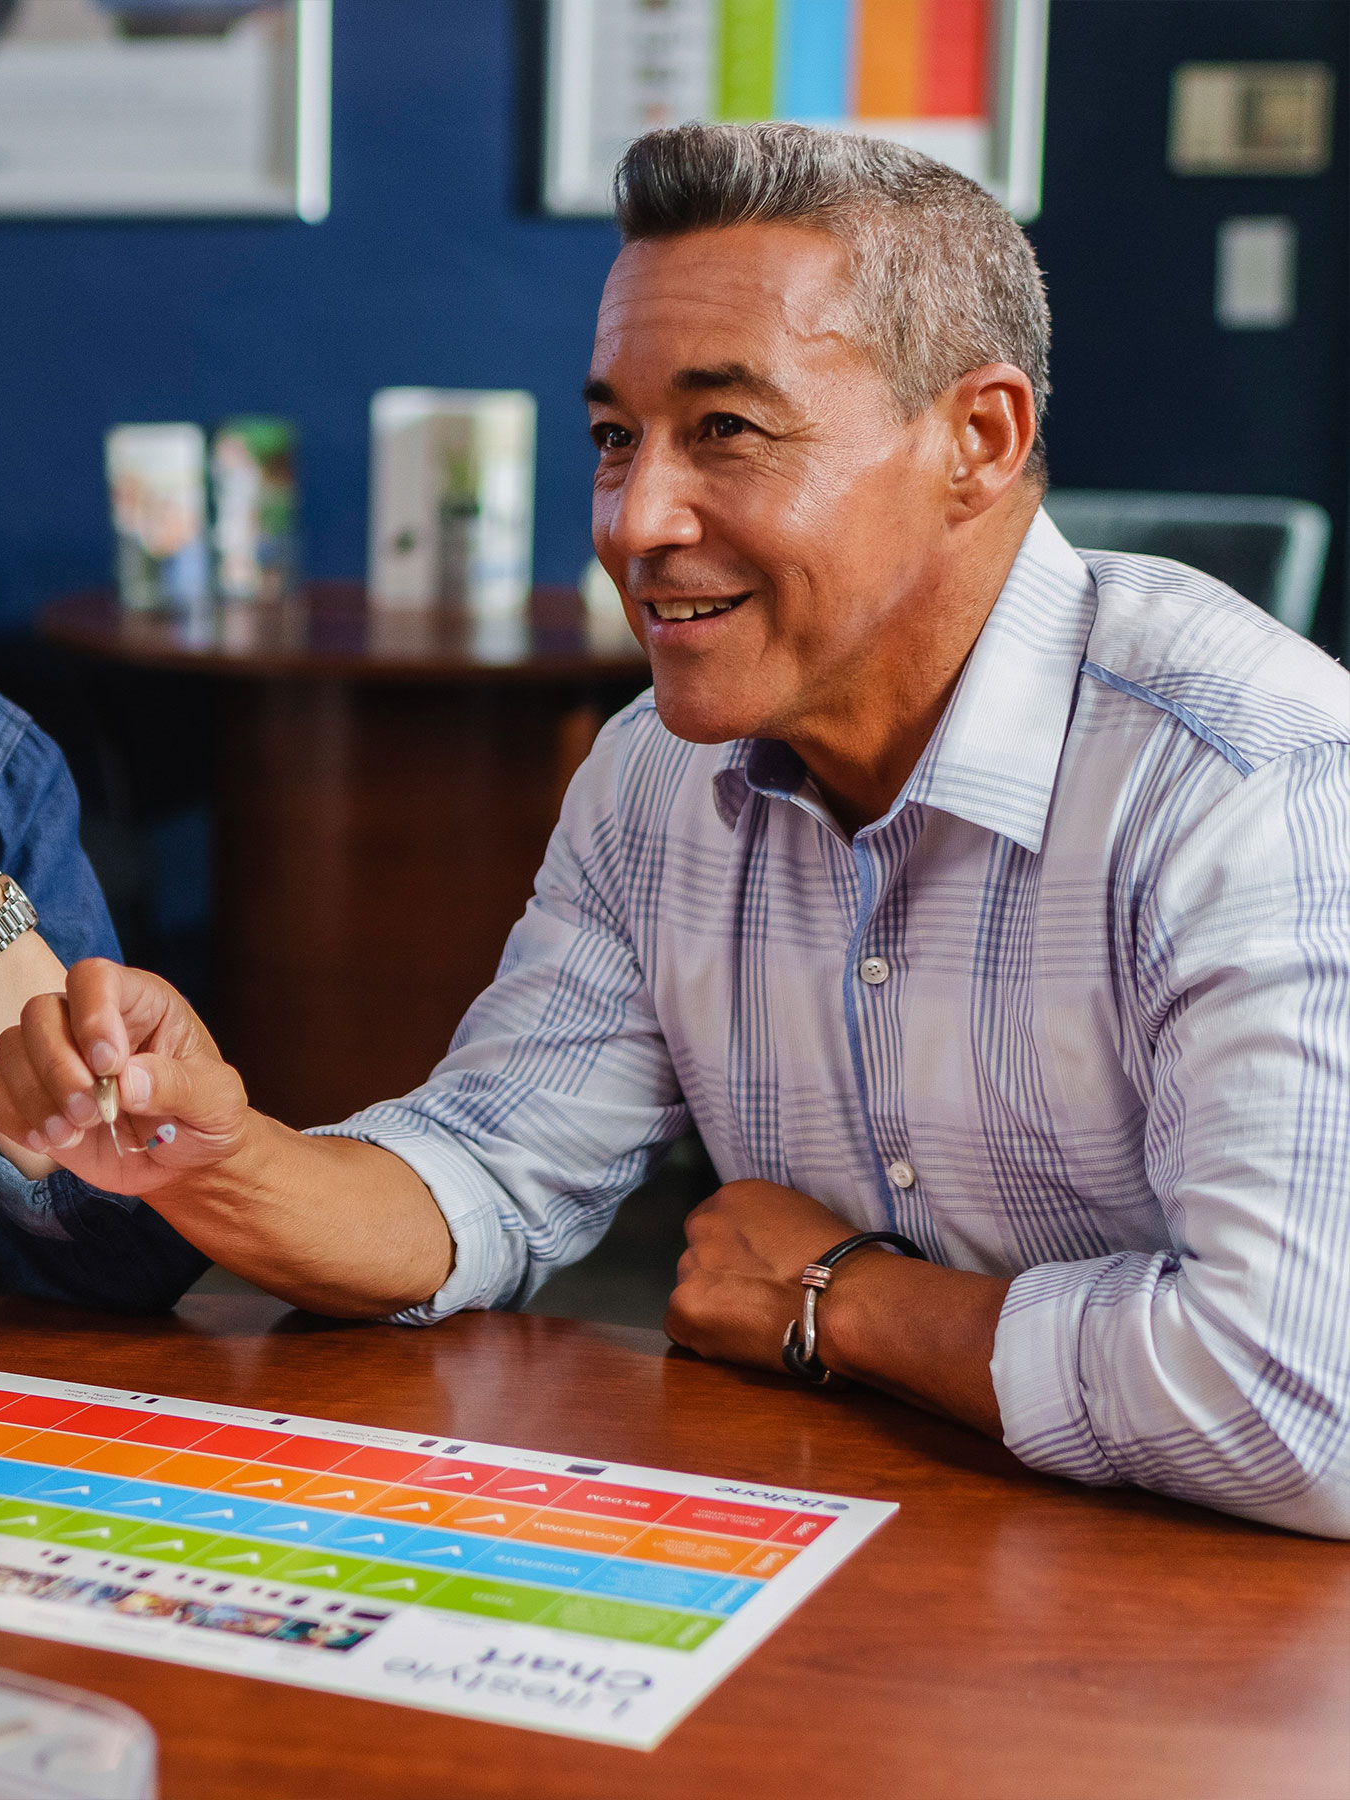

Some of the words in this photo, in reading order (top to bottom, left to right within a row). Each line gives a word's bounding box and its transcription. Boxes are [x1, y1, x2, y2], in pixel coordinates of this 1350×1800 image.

[586, 1493, 651, 1509] SELDOM
[714, 1485, 825, 1508] Beltone
[533, 1521, 628, 1543] OCCASIONAL
[476, 1647, 654, 1695] Chart
[383, 1656, 631, 1719] Lifestyle
